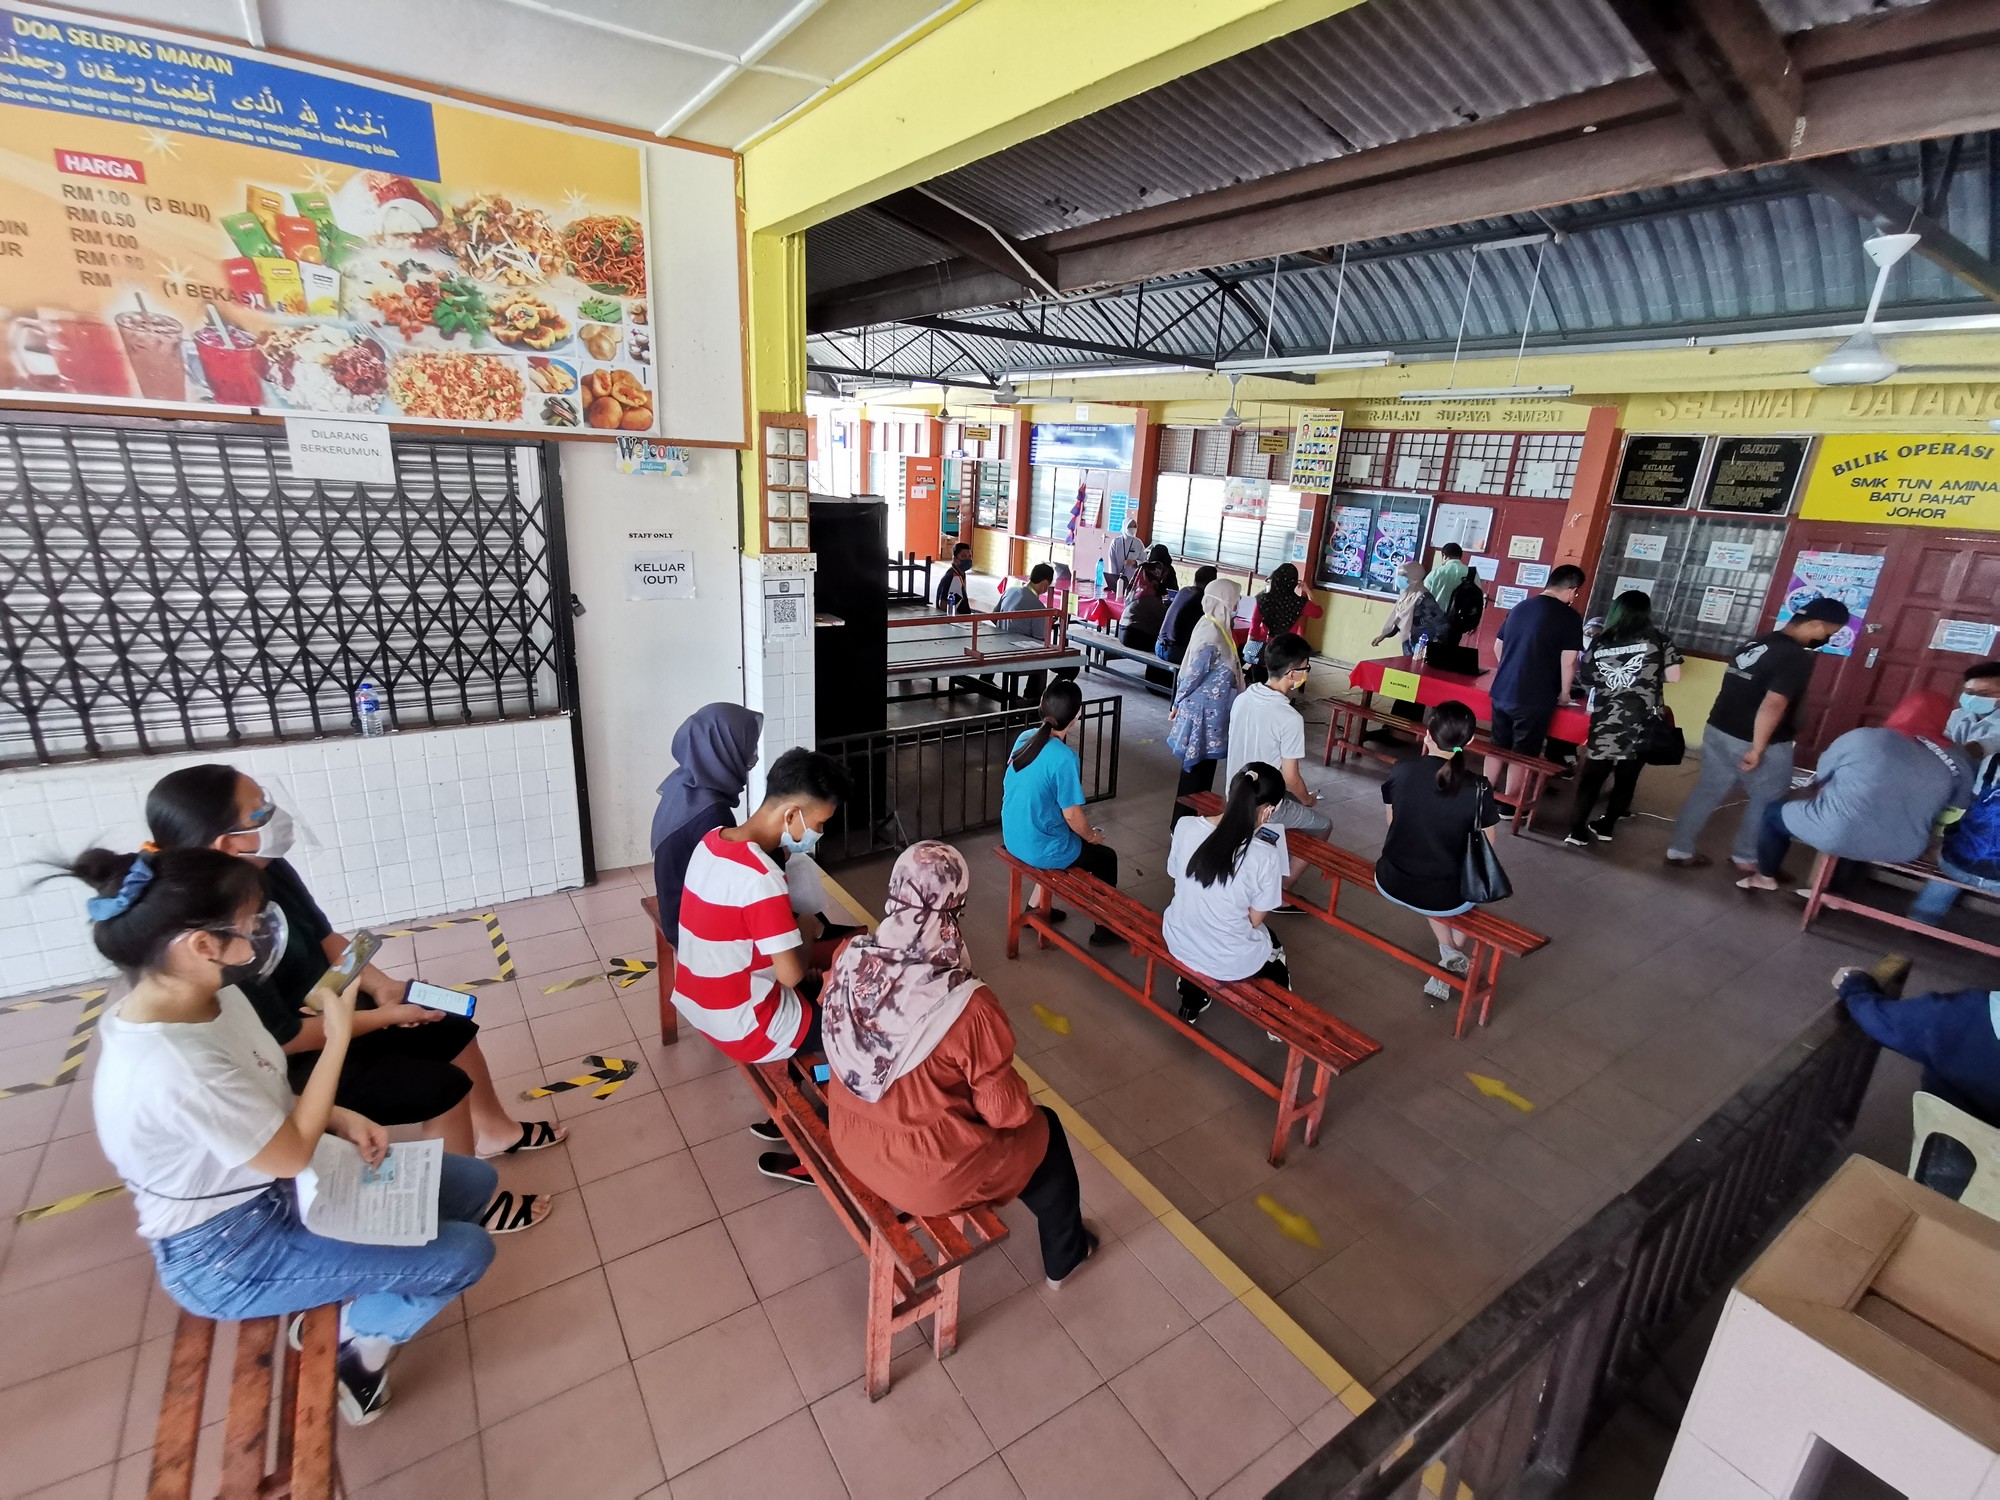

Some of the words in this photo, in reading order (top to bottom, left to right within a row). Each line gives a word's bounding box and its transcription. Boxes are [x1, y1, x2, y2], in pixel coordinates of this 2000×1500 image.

[12, 16, 64, 43] DOA
[66, 27, 153, 60] SELEPAS
[156, 44, 234, 76] MAKAN
[64, 154, 138, 181] HARGA
[61, 184, 94, 202] RM
[169, 199, 211, 223] BIJI)
[65, 205, 99, 224] RM
[101, 210, 136, 228] 0.50
[70, 227, 103, 245] RM
[74, 248, 108, 267] RM
[78, 270, 112, 287] RM
[1654, 388, 1822, 421] SELAMAT
[1436, 409, 1491, 422] SUPAYA
[1502, 410, 1564, 422] SAMPAI
[311, 429, 369, 442] DILARANG
[300, 443, 383, 457] BERKERUMUN.
[616, 436, 689, 462] Welcome
[1740, 444, 1780, 454] OBJEKTIF
[1832, 450, 1888, 477] BILIK
[1897, 443, 1995, 460] OPERASI
[1642, 464, 1675, 472] MATLAMAT
[1851, 477, 1888, 488] SMK
[1898, 478, 1932, 489] TUN
[1869, 492, 1913, 503] BATU
[1918, 493, 1975, 506] PAHAT
[1886, 507, 1946, 519] JOHOR
[634, 563, 686, 573] KELUAR
[643, 575, 678, 585] (OUT)
